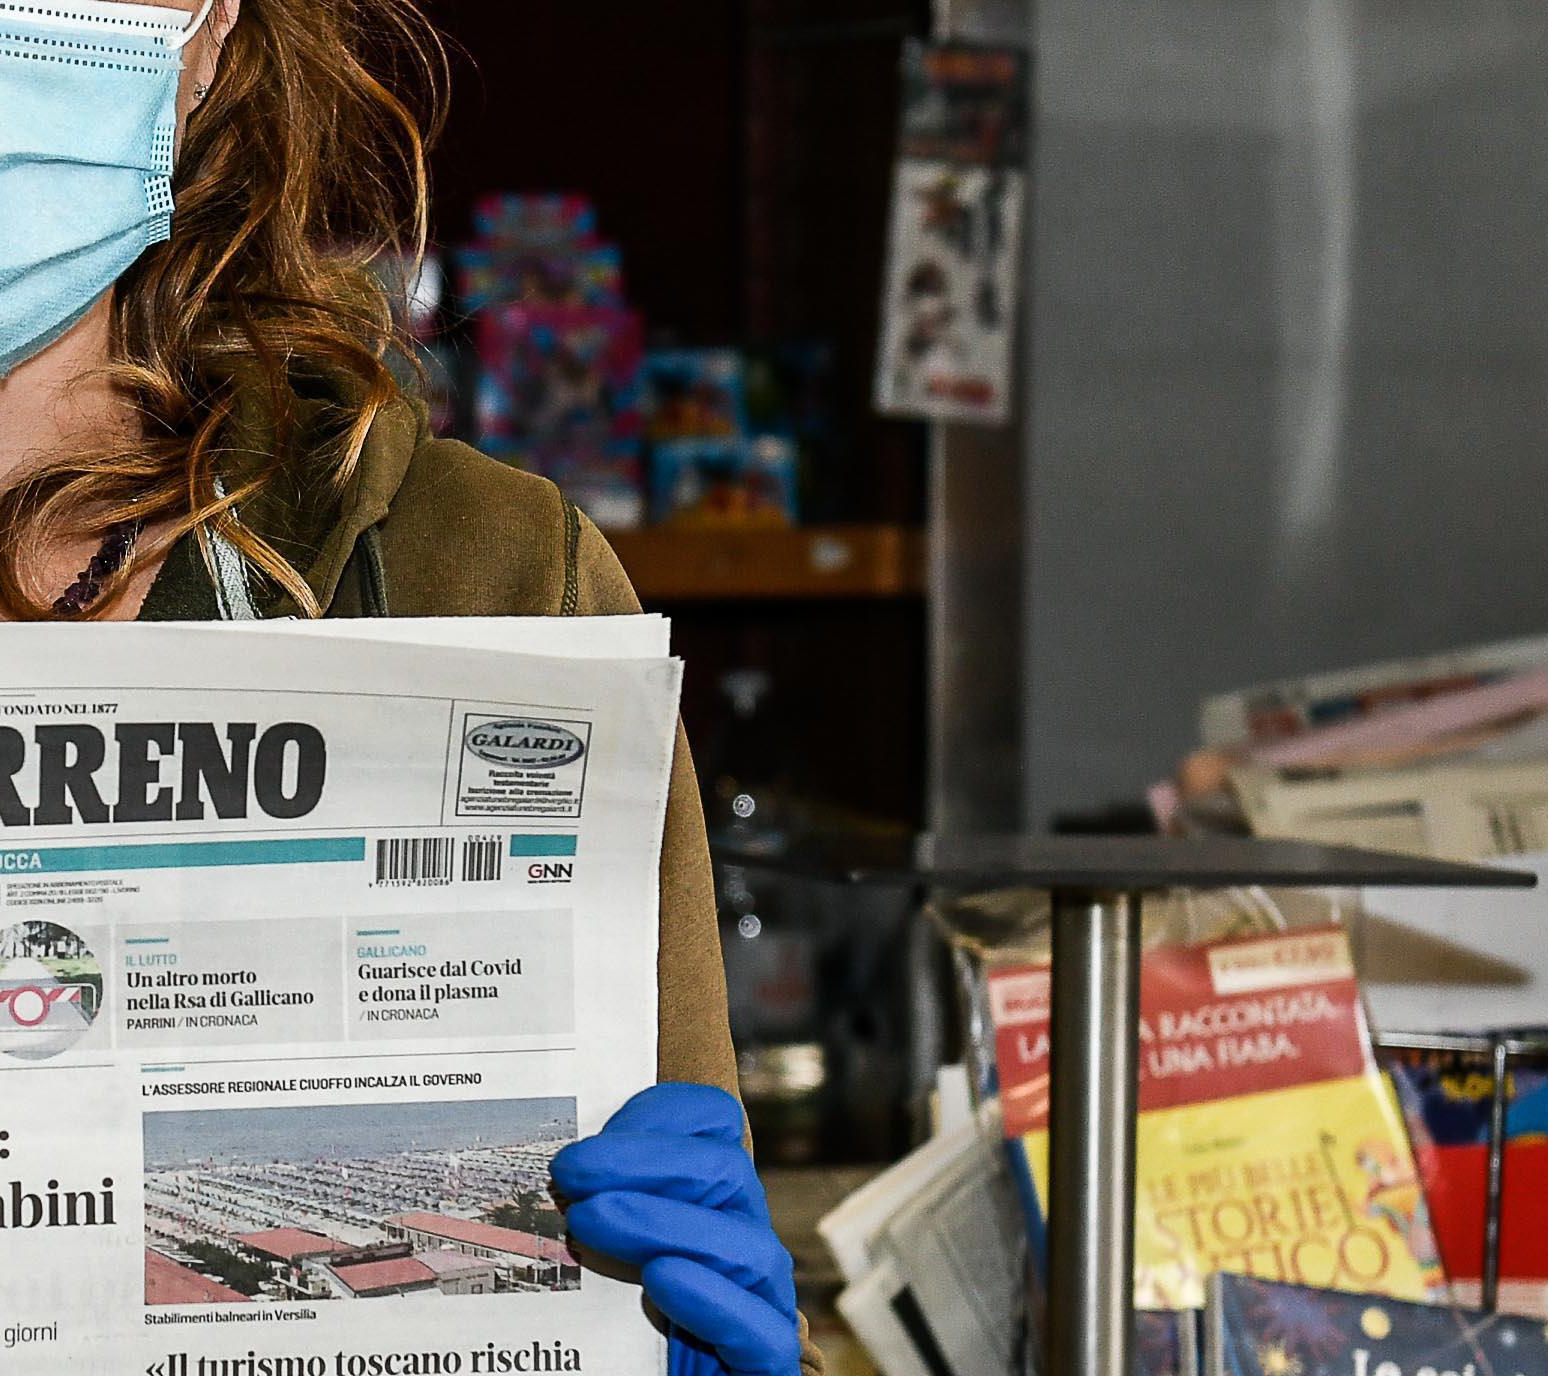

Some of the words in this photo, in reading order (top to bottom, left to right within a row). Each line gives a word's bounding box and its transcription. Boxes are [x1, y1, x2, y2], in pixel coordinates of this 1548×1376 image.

[66, 703, 90, 716] NEL
[92, 703, 119, 715] 1877
[470, 731, 576, 753] GALARDI
[528, 864, 574, 880] GNN
[356, 944, 426, 958] GALLICANO
[126, 972, 153, 988] Un
[156, 970, 198, 987] altro
[202, 969, 256, 985] morto
[358, 961, 437, 980] Guarisce
[440, 960, 467, 978] dal
[470, 958, 522, 976] Covid
[126, 993, 170, 1011] nella
[173, 992, 207, 1009] Rsa
[211, 990, 226, 1008] di
[230, 989, 314, 1007] Gallicano
[358, 988, 369, 1003] e
[372, 985, 416, 1002] dona
[419, 984, 431, 1001] il
[434, 984, 499, 1004] plasma
[141, 1081, 226, 1097] L'ASSESSORE
[228, 1078, 297, 1094] REGIONALE
[299, 1076, 352, 1091] CIUOFFO
[354, 1075, 408, 1089] INCALZA
[410, 1075, 420, 1087] IL
[423, 1072, 482, 1086] GOVERNO
[3, 1320, 59, 1349] giorni
[470, 1340, 582, 1376] rischia
